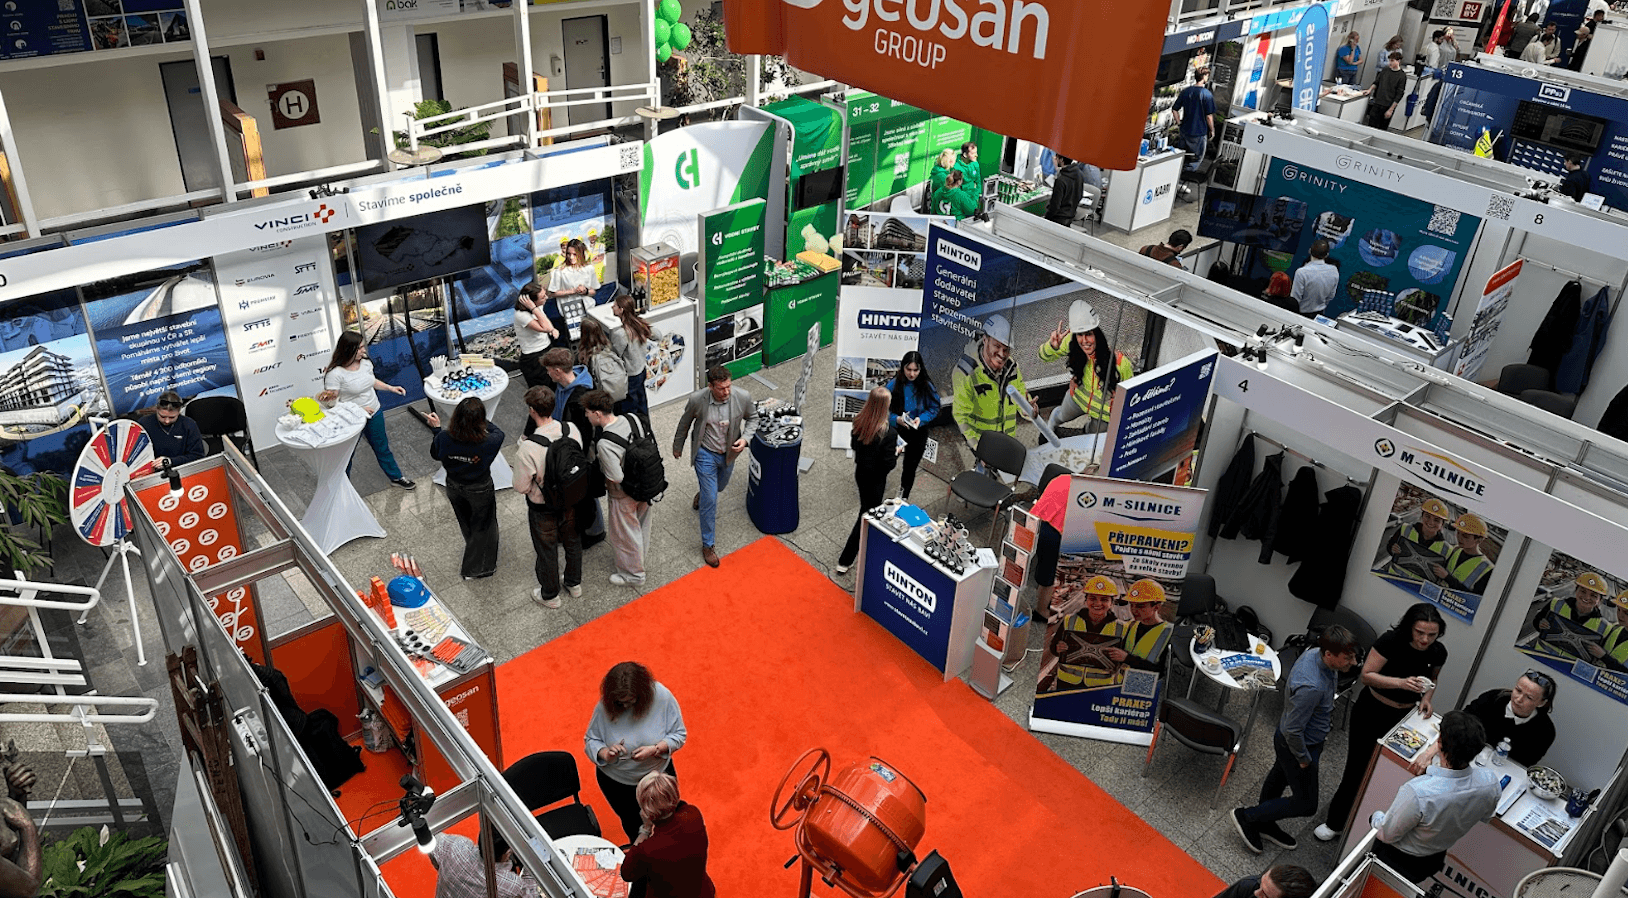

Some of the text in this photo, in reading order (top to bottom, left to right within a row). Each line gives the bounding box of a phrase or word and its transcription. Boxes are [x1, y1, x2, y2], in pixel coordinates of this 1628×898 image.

[874, 28, 946, 69] GROUP
[1451, 69, 1464, 79] 13
[286, 95, 302, 114] H
[852, 106, 862, 116] 31
[870, 102, 880, 112] 32
[1258, 134, 1264, 144] 9
[1336, 154, 1405, 182] GRINITY
[1282, 164, 1347, 194] GRINITY
[358, 183, 463, 212] Stavíme společně
[254, 214, 309, 230] VINCI
[276, 222, 316, 233] CONSTRUCTION
[1534, 214, 1544, 224] 8
[249, 242, 278, 252] VINCI
[939, 242, 978, 266] HINTON
[936, 264, 976, 288] Generální
[933, 289, 960, 307] staveb
[934, 276, 976, 302] dodavatel
[862, 314, 922, 328] HINTON
[932, 313, 976, 338] stavitelství
[939, 304, 982, 329] pozemním
[141, 326, 168, 338] největší
[169, 320, 197, 330] stavební
[904, 333, 918, 342] BAV
[121, 334, 206, 360] Pomáháme vytvářet lepší
[129, 338, 160, 350] skupinou
[167, 332, 177, 340] ČR
[140, 348, 192, 364] místa pro život.
[130, 370, 152, 381] Téměř
[174, 356, 208, 370] odborníků
[124, 364, 217, 393] působí napříč všemi regiony
[146, 386, 165, 396] obory
[166, 375, 206, 390] stavebnictví.
[1238, 379, 1249, 393] 4
[1130, 377, 1176, 408] Co děláme?
[1131, 394, 1182, 420] Pozemní stavitelství
[1152, 417, 1170, 430] staveb
[1400, 449, 1486, 497] M-SILNICE
[1102, 497, 1182, 516] M-SILNICE
[1108, 530, 1189, 552] PŘIPRAVENI?
[1114, 544, 1135, 556] Pojďte
[1144, 548, 1160, 558] námi
[1161, 550, 1185, 560] stavět.
[1139, 563, 1156, 572] velké
[1158, 566, 1182, 577] stavby!
[1142, 557, 1160, 568] školy
[1161, 561, 1184, 570] rovnou
[888, 566, 933, 606] HINTON
[886, 583, 904, 601] STAVĚT
[906, 596, 917, 610] NÁS
[1444, 590, 1466, 604] PRAXE?
[1600, 670, 1626, 685] PRAXE?
[1612, 681, 1628, 694] kariér
[444, 685, 480, 709] geosan
[1112, 696, 1152, 710] PRAXE?
[1092, 703, 1150, 718] Lepší kariéra?
[1100, 714, 1118, 725] Tady
[1128, 716, 1148, 728] máš!
